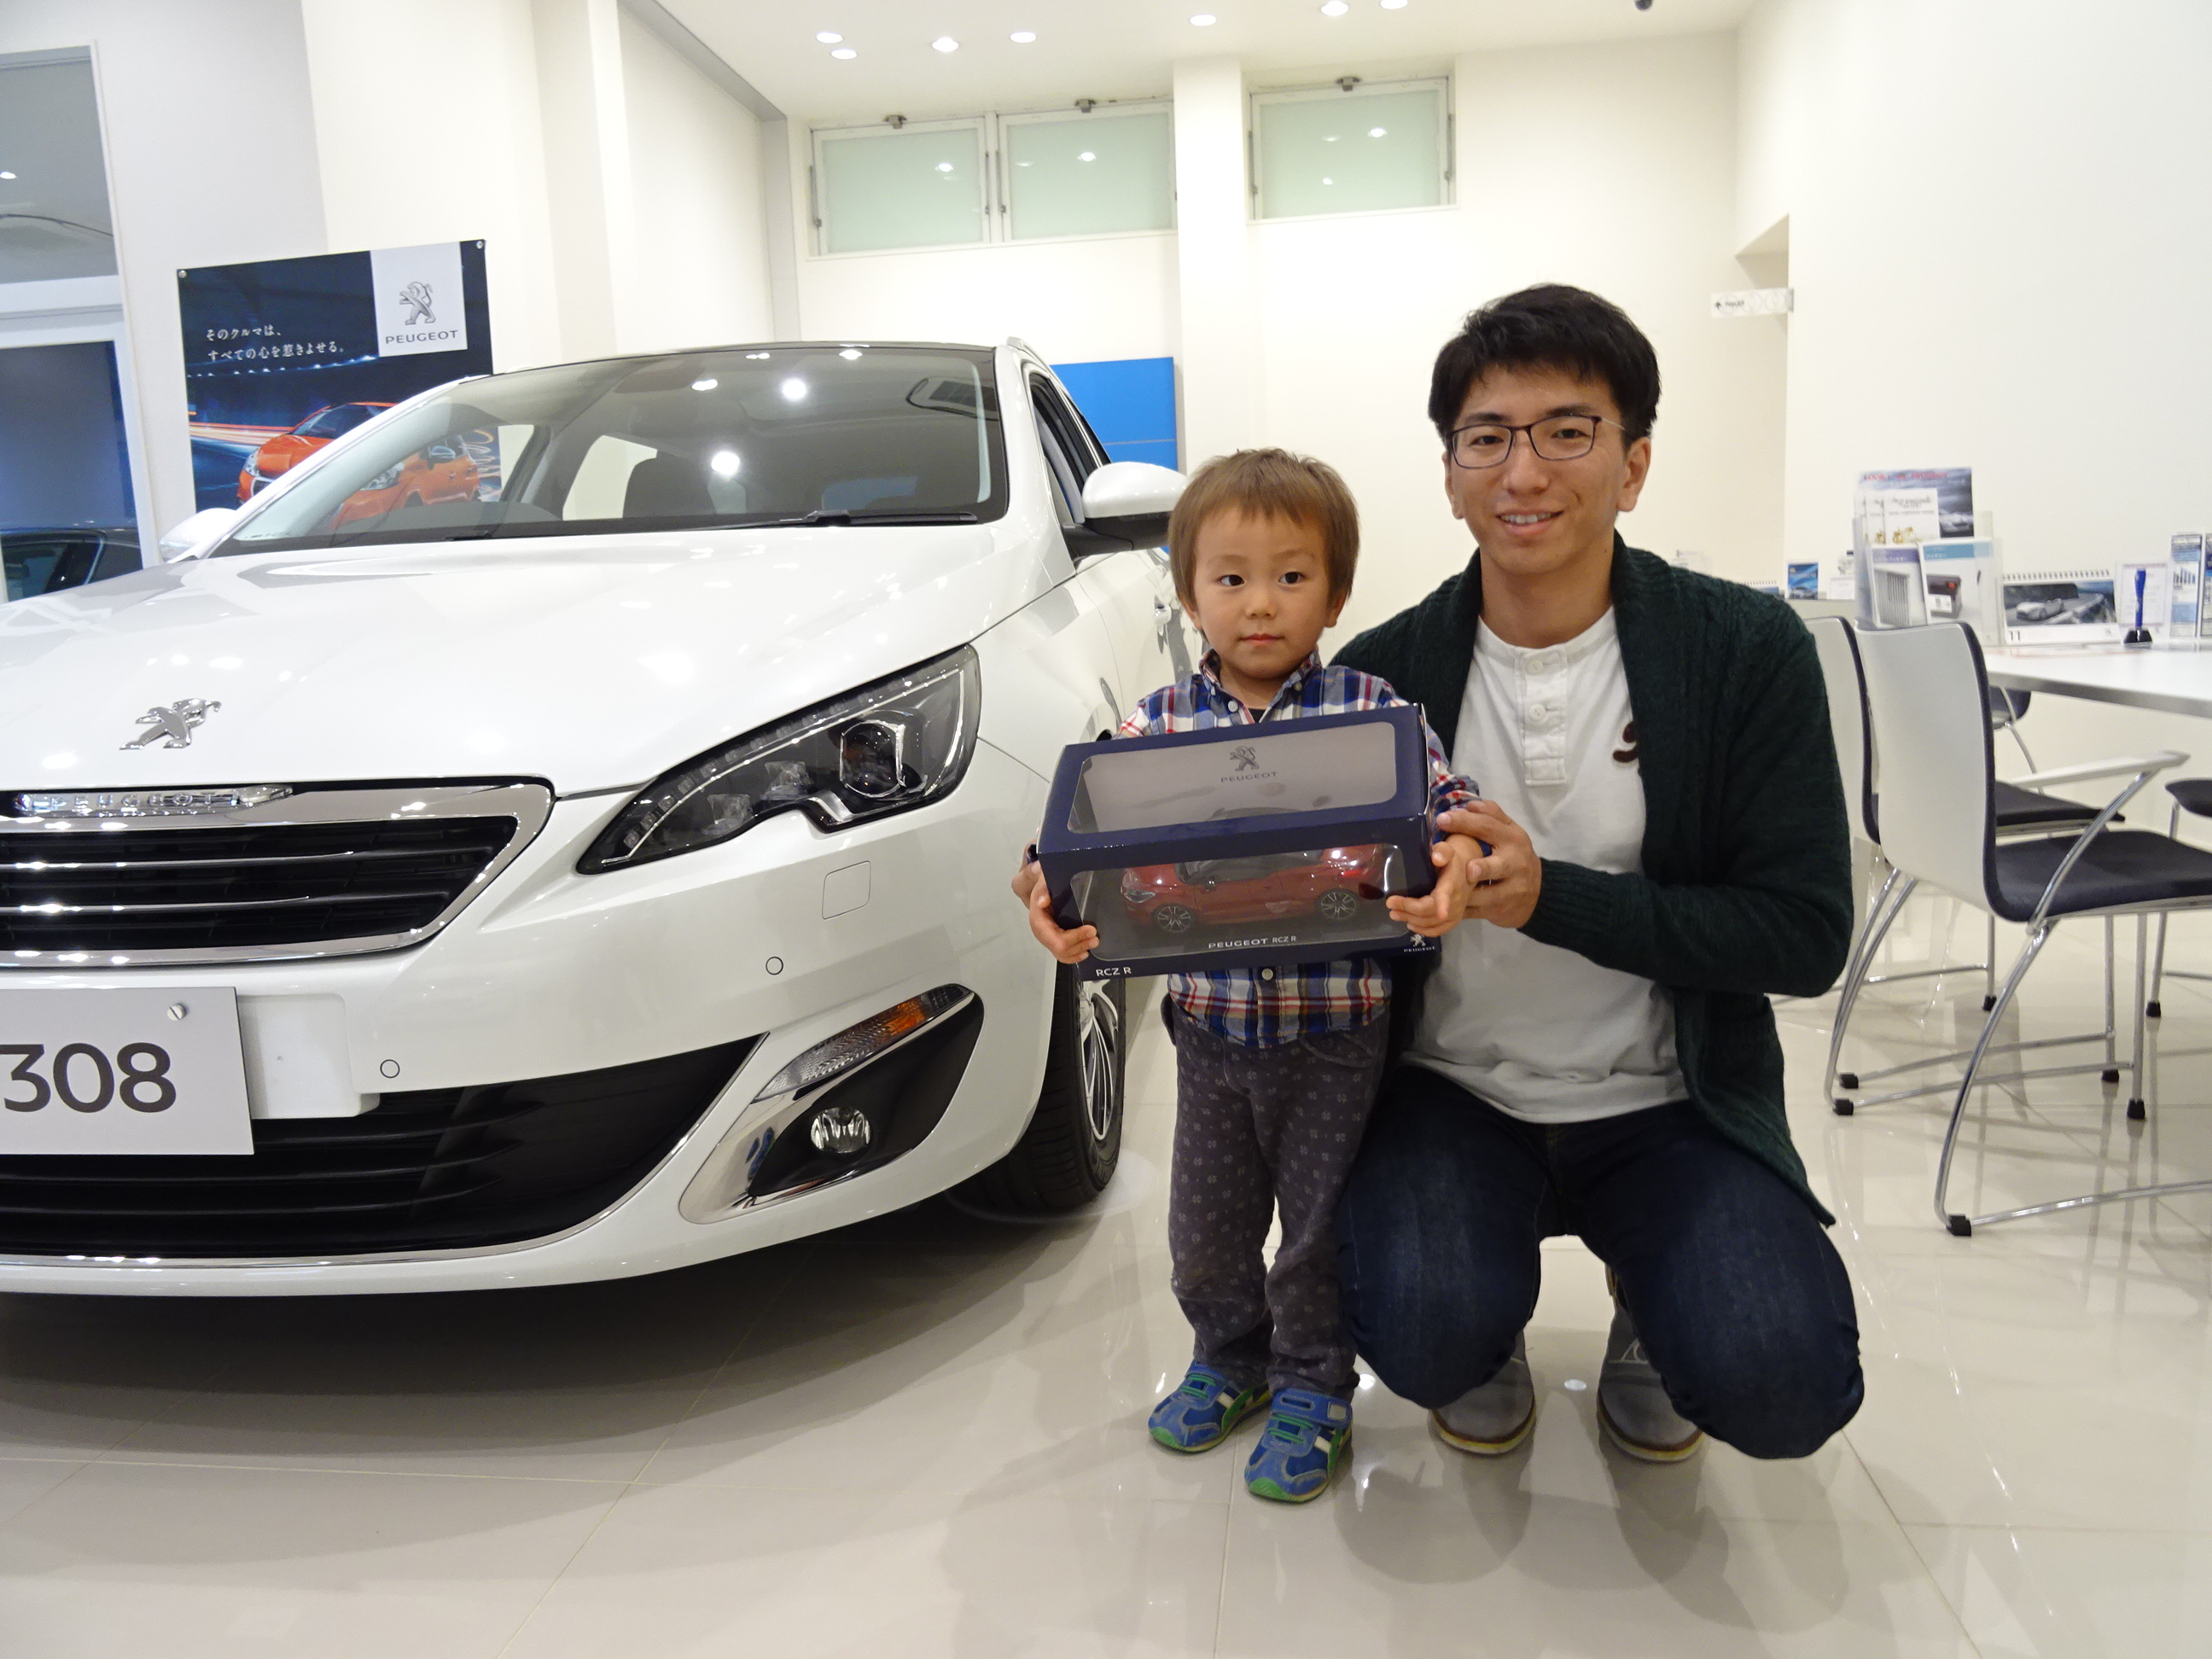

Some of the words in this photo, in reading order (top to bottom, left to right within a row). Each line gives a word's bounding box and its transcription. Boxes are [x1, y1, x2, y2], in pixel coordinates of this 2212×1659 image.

[206, 324, 282, 341] そのクルマは、
[386, 329, 458, 344] PEUGEOT
[1220, 771, 1277, 783] PEUGEOT
[1208, 938, 1268, 949] PEUGEOT
[1096, 967, 1121, 977] RCZ
[1123, 966, 1132, 975] R
[0, 1042, 177, 1114] 308
